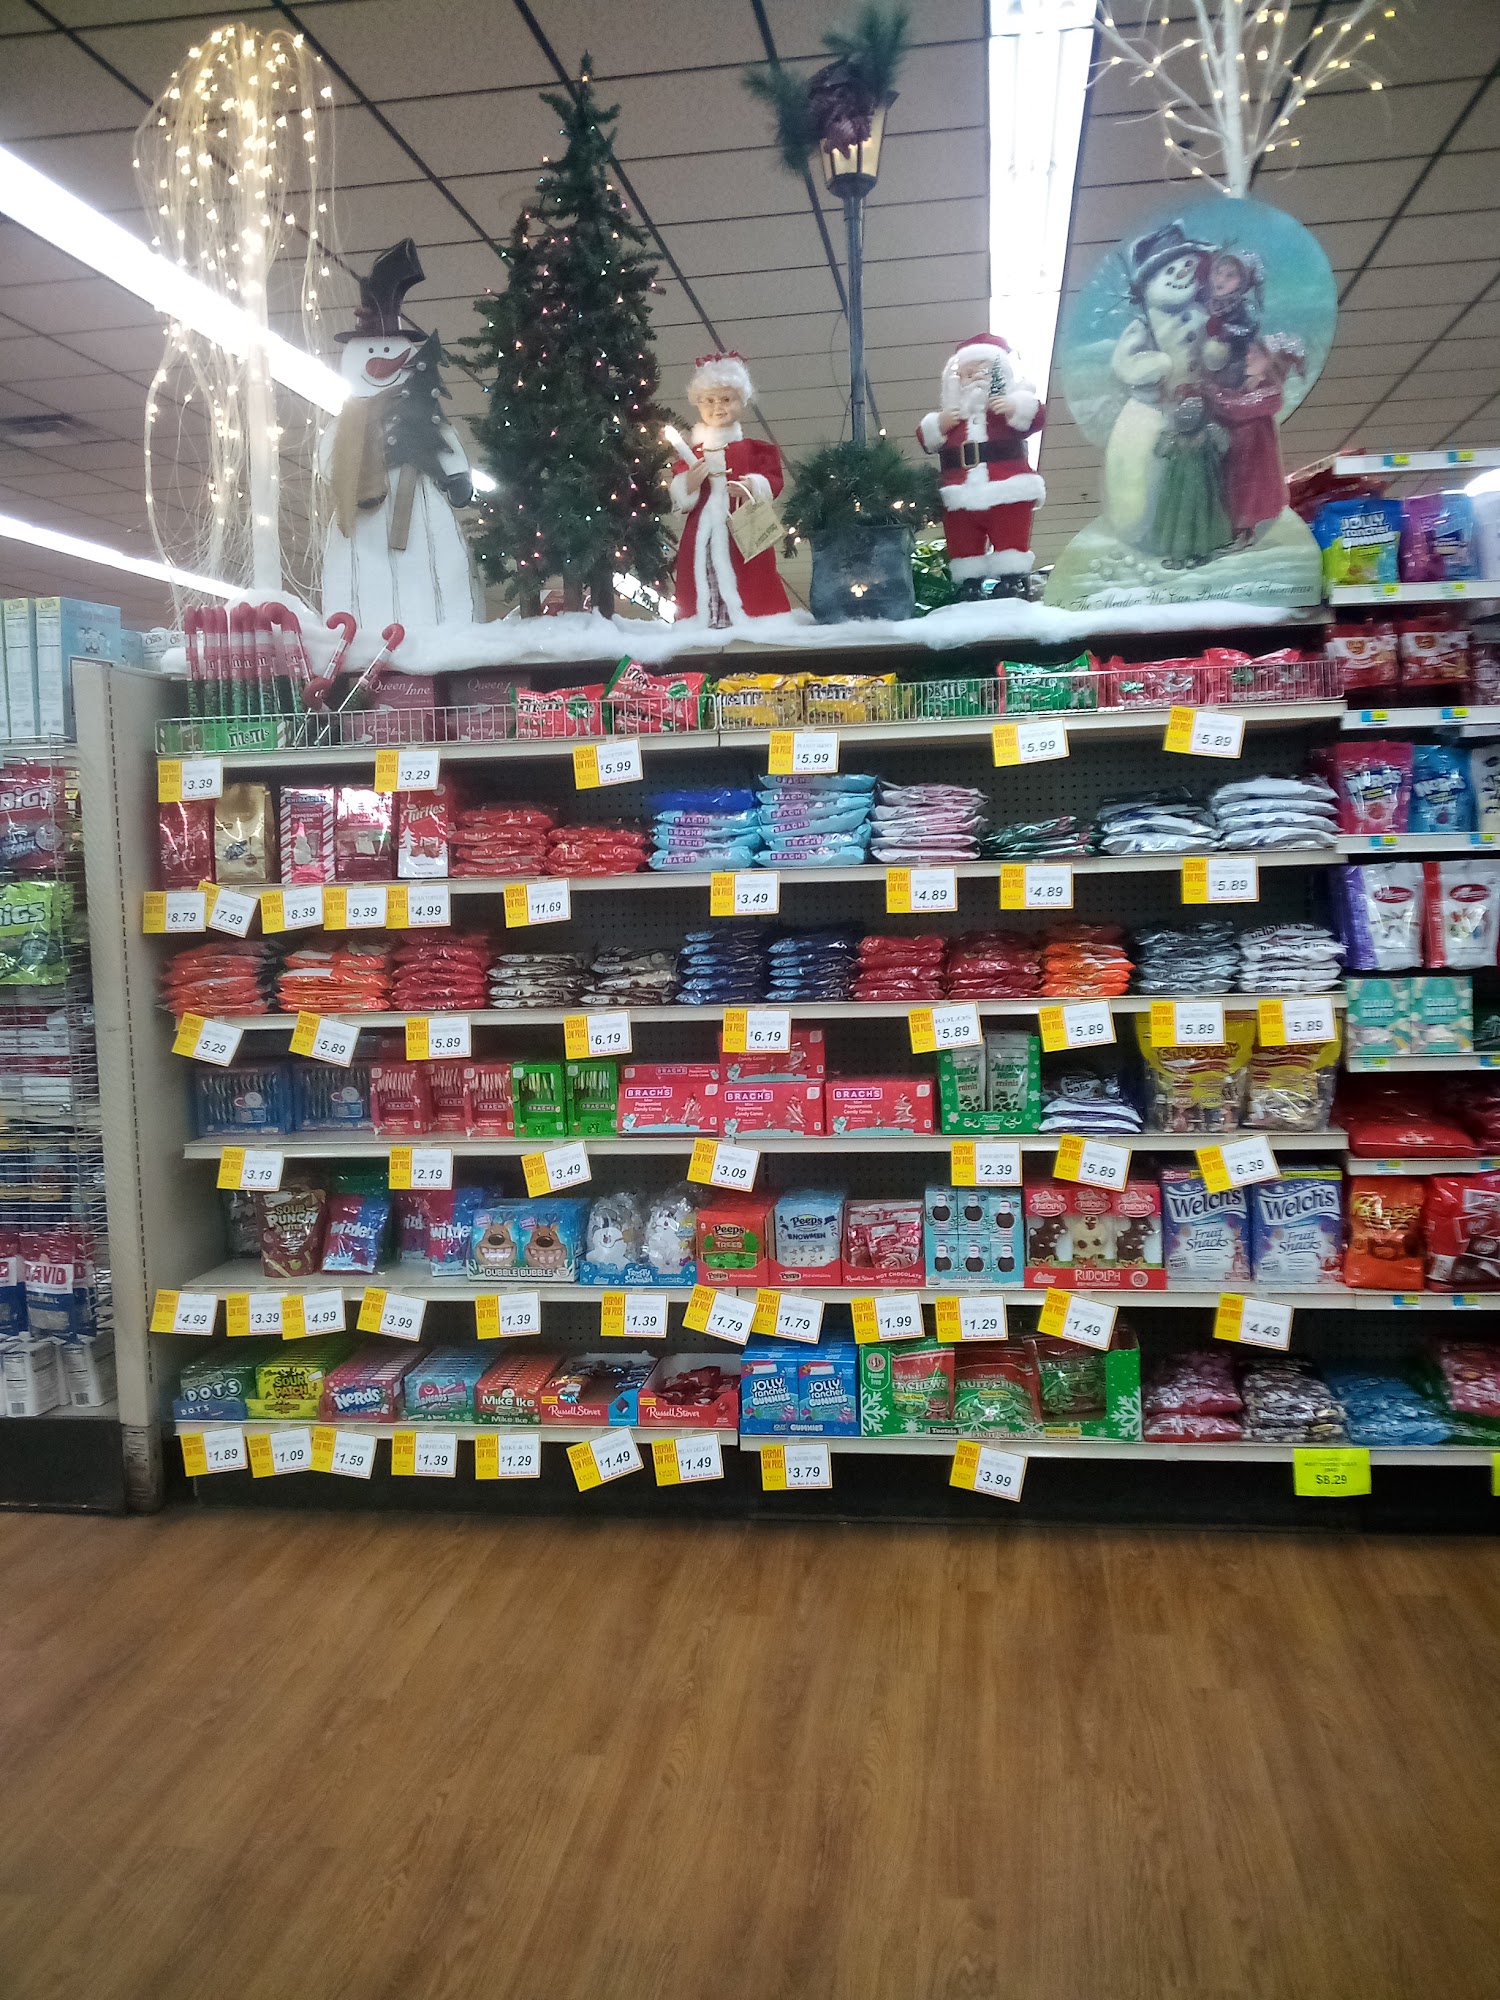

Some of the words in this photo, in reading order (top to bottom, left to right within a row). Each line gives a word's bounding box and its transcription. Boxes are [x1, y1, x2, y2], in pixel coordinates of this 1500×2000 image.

[1196, 585, 1230, 601] Build
[369, 679, 406, 691] Queen
[1022, 740, 1055, 753] $5.99
[797, 753, 829, 764] $5.99
[600, 760, 631, 774] $5.99
[401, 769, 430, 781] $3.29
[184, 778, 213, 790] $3.39
[403, 803, 446, 823] Turtles
[786, 838, 822, 847] BRACHS
[771, 852, 807, 860] BRACHS
[713, 876, 734, 888] EVERYDAY
[888, 872, 909, 883] EVERYDAY
[888, 883, 897, 892] LOW
[898, 883, 909, 892] PRICE
[1212, 880, 1248, 891] $5.89
[506, 888, 525, 899] EVERYDAY
[713, 887, 721, 897] LOW
[722, 887, 734, 897] PRICE
[915, 890, 947, 900] $4.89
[1029, 886, 1063, 898] $4.89
[507, 898, 515, 908] LOW
[515, 896, 526, 907] PRICE
[737, 893, 768, 904] $3.49
[287, 906, 316, 919] $8.39
[348, 907, 377, 918] $9.39
[411, 905, 442, 916] $4.99
[531, 901, 561, 914] $11.69
[168, 912, 196, 923] $8.79
[215, 909, 243, 925] $7.99
[1070, 1023, 1104, 1036] $5.89
[1180, 1023, 1215, 1034] $5.89
[1289, 1020, 1323, 1032] $5.89
[750, 1030, 781, 1042] $6.19
[937, 1026, 970, 1039] $5.89
[431, 1037, 461, 1048] $5.89
[591, 1033, 621, 1046] $6.19
[200, 1039, 226, 1055] $5.29
[318, 1039, 346, 1055] $5.89
[627, 1089, 671, 1097] BRACHS
[835, 1089, 881, 1098] BRACHS
[1066, 1083, 1090, 1095] bolis
[727, 1092, 771, 1101] BRACHS
[551, 1164, 581, 1180] $3.49
[717, 1164, 747, 1179] $3.09
[979, 1164, 1012, 1175] $2.39
[1083, 1161, 1116, 1178] $5.89
[1231, 1159, 1265, 1175] $6.39
[244, 1169, 272, 1181] $3.19
[414, 1169, 443, 1180] $2.19
[1263, 1187, 1335, 1220] Welch's
[276, 1205, 306, 1215] SOUR
[790, 1216, 823, 1227] Peeps
[713, 1224, 745, 1236] Peeps
[1195, 1228, 1223, 1240] Fruit
[1287, 1231, 1316, 1242] Fruit
[1185, 1239, 1229, 1251] Snacks
[1278, 1241, 1321, 1254] Snacks
[485, 1268, 518, 1277] DUBBLE
[520, 1268, 553, 1277] BUBBLE
[1075, 1270, 1121, 1282] RUDOLPH
[178, 1313, 207, 1325] $4.99
[251, 1312, 280, 1324] $3.39
[307, 1310, 337, 1324] $4.99
[384, 1314, 413, 1329] $3.99
[502, 1314, 531, 1326] $1.39
[627, 1315, 657, 1327] $1.39
[712, 1314, 743, 1332] $1.79
[779, 1315, 810, 1330] $1.79
[880, 1316, 912, 1329] $1.99
[965, 1318, 997, 1330] $1.29
[1068, 1317, 1101, 1336] $1.49
[1246, 1321, 1281, 1337] $4.49
[274, 1376, 306, 1386] SOUR
[752, 1378, 783, 1392] JOLLY
[809, 1379, 840, 1393] JOLLY
[187, 1380, 238, 1401] DOTS
[275, 1386, 308, 1397] PATCH
[754, 1387, 787, 1397] rancher
[811, 1389, 844, 1399] rancher
[482, 1396, 513, 1407] Mike
[516, 1396, 535, 1407] Ike
[753, 1393, 790, 1406] GUMMIES
[809, 1395, 847, 1407] GUMMIES
[181, 1404, 210, 1415] DOTS
[548, 1405, 577, 1416] Russell
[578, 1405, 601, 1416] Stover
[646, 1407, 676, 1417] Russell
[677, 1407, 700, 1418] Stover
[209, 1449, 238, 1461] $1.89
[274, 1450, 304, 1463] $1.09
[335, 1452, 364, 1466] $1.59
[418, 1455, 448, 1466] $1.39
[502, 1455, 532, 1467] $1.29
[600, 1451, 631, 1468] $1.49
[680, 1456, 712, 1470] $1.49
[788, 1466, 820, 1478] $3.79
[979, 1469, 1012, 1487] $3.99
